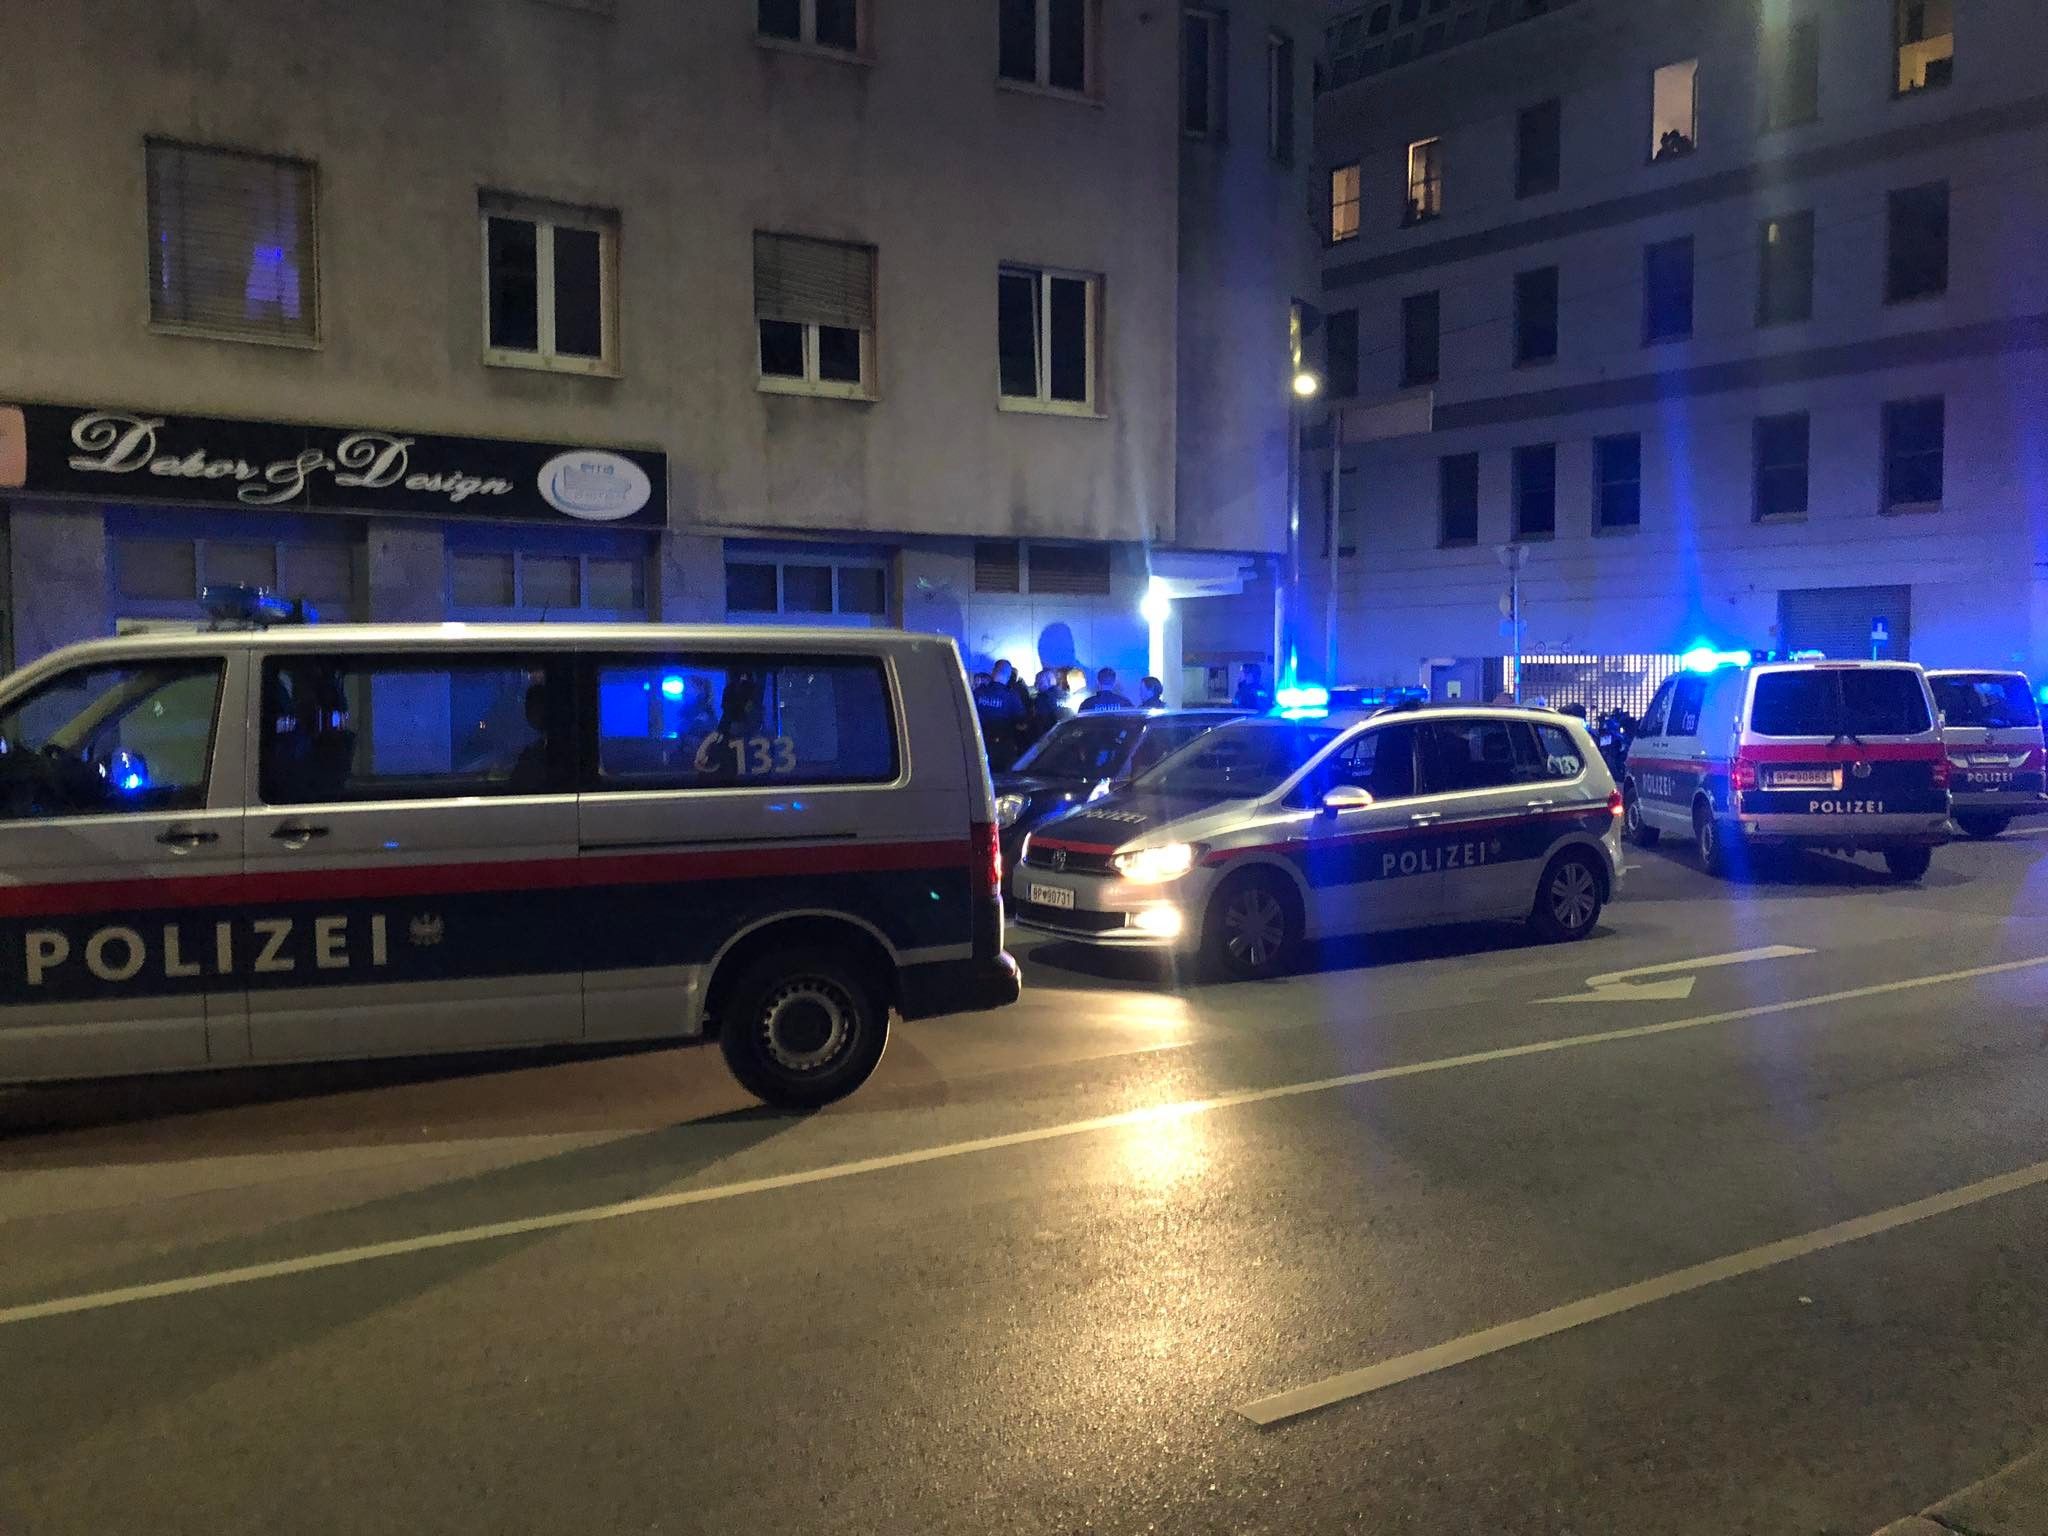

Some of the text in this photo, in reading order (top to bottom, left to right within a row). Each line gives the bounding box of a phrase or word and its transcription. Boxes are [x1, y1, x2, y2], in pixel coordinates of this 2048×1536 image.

[237, 448, 336, 505] &
[334, 431, 514, 504] Design
[728, 736, 797, 775] 133
[1642, 773, 1672, 796] POLIZEI
[1967, 772, 2014, 783] POLIZEI
[1809, 801, 1883, 813] POLIZEI
[1382, 842, 1486, 877] POLIZEI
[25, 914, 388, 986] POLIZEI
